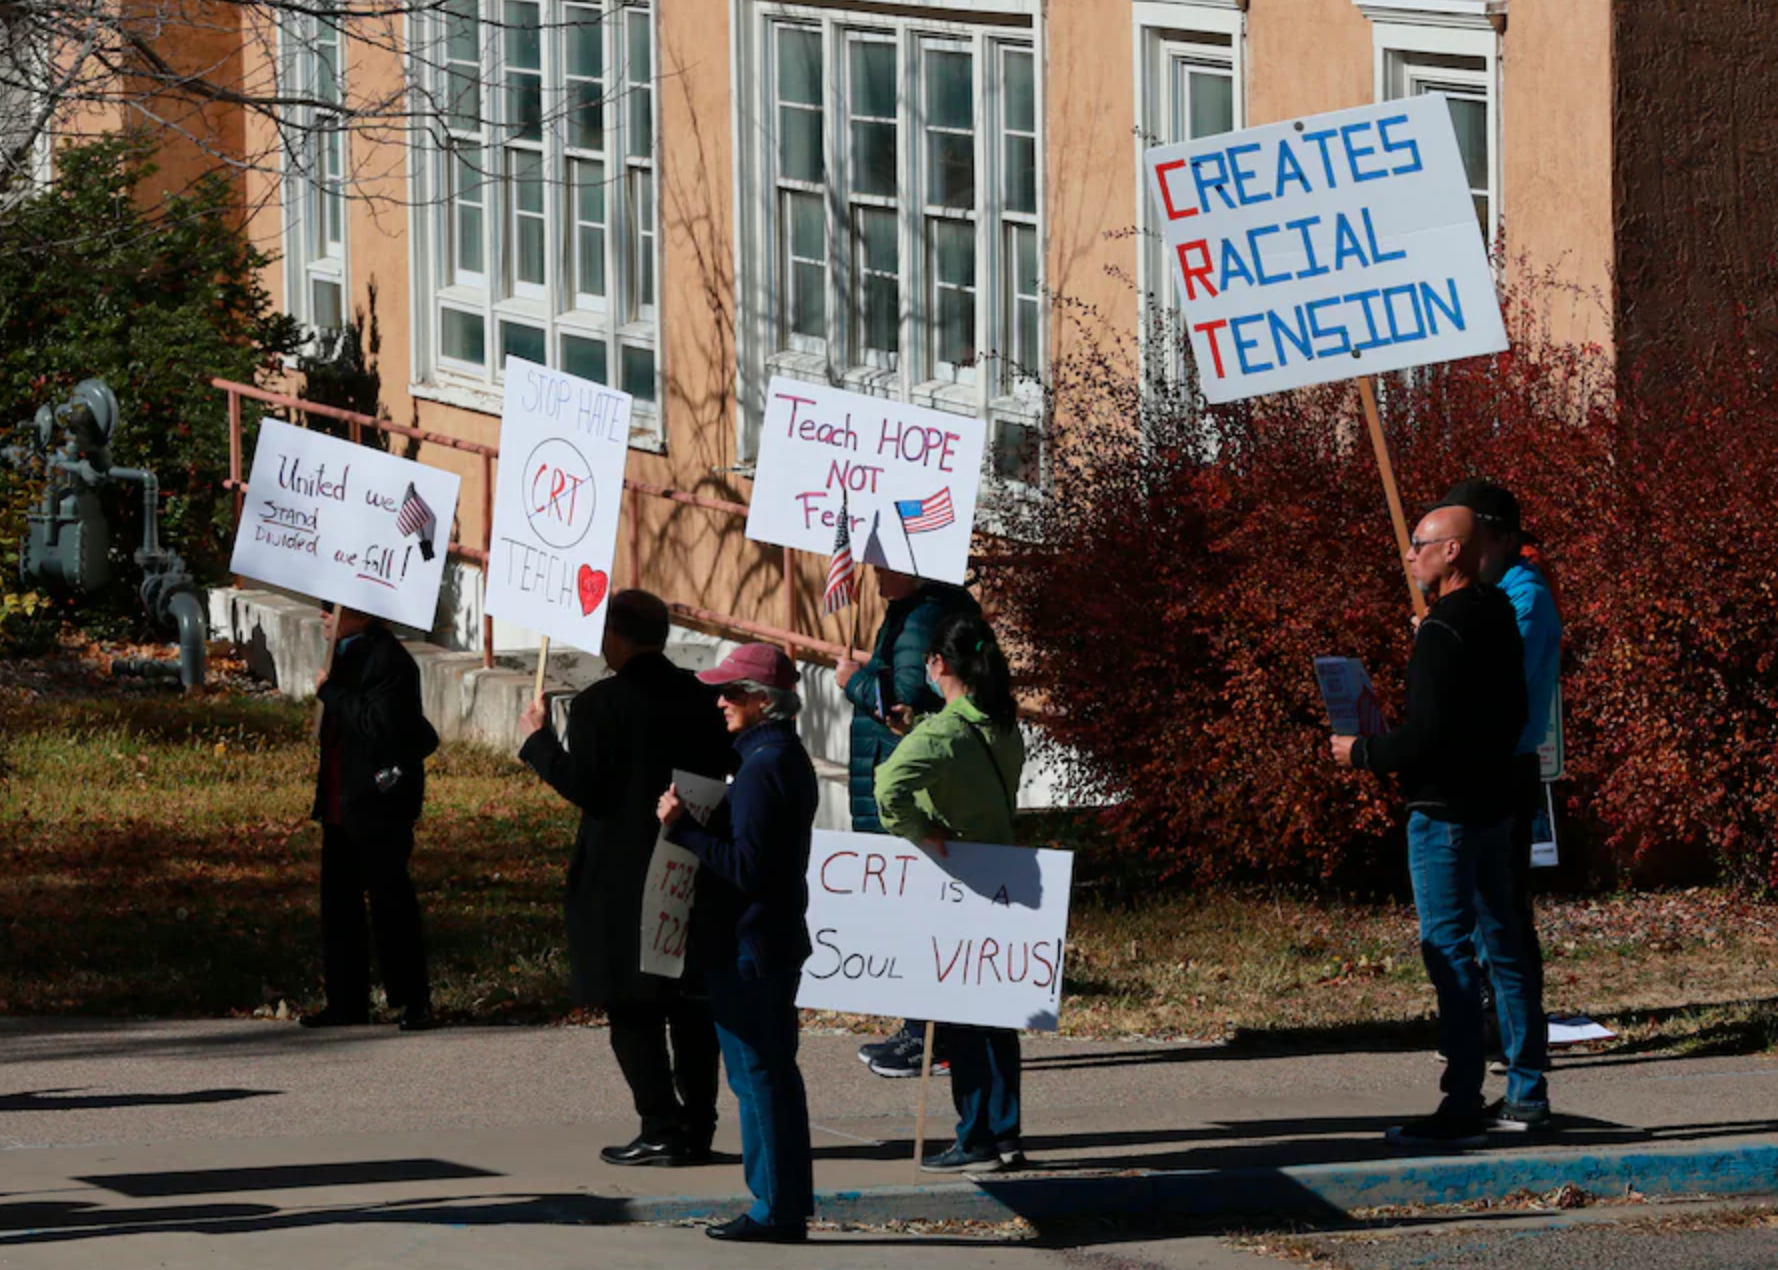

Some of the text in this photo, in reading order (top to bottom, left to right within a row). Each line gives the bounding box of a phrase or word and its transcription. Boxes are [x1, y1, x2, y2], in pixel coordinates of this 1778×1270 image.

[1154, 113, 1424, 221] CREATES
[1175, 207, 1408, 301] RACIAL
[1193, 278, 1467, 380] TENSION
[522, 369, 625, 443] STOP HATE
[775, 393, 961, 473] Teach HOPE
[278, 453, 397, 513] United we
[531, 463, 584, 527] CRT
[825, 459, 885, 494] NOT
[795, 491, 866, 533] Fer
[333, 548, 358, 567] we
[500, 536, 575, 609] TEACH
[820, 850, 1011, 909] CRT IS A
